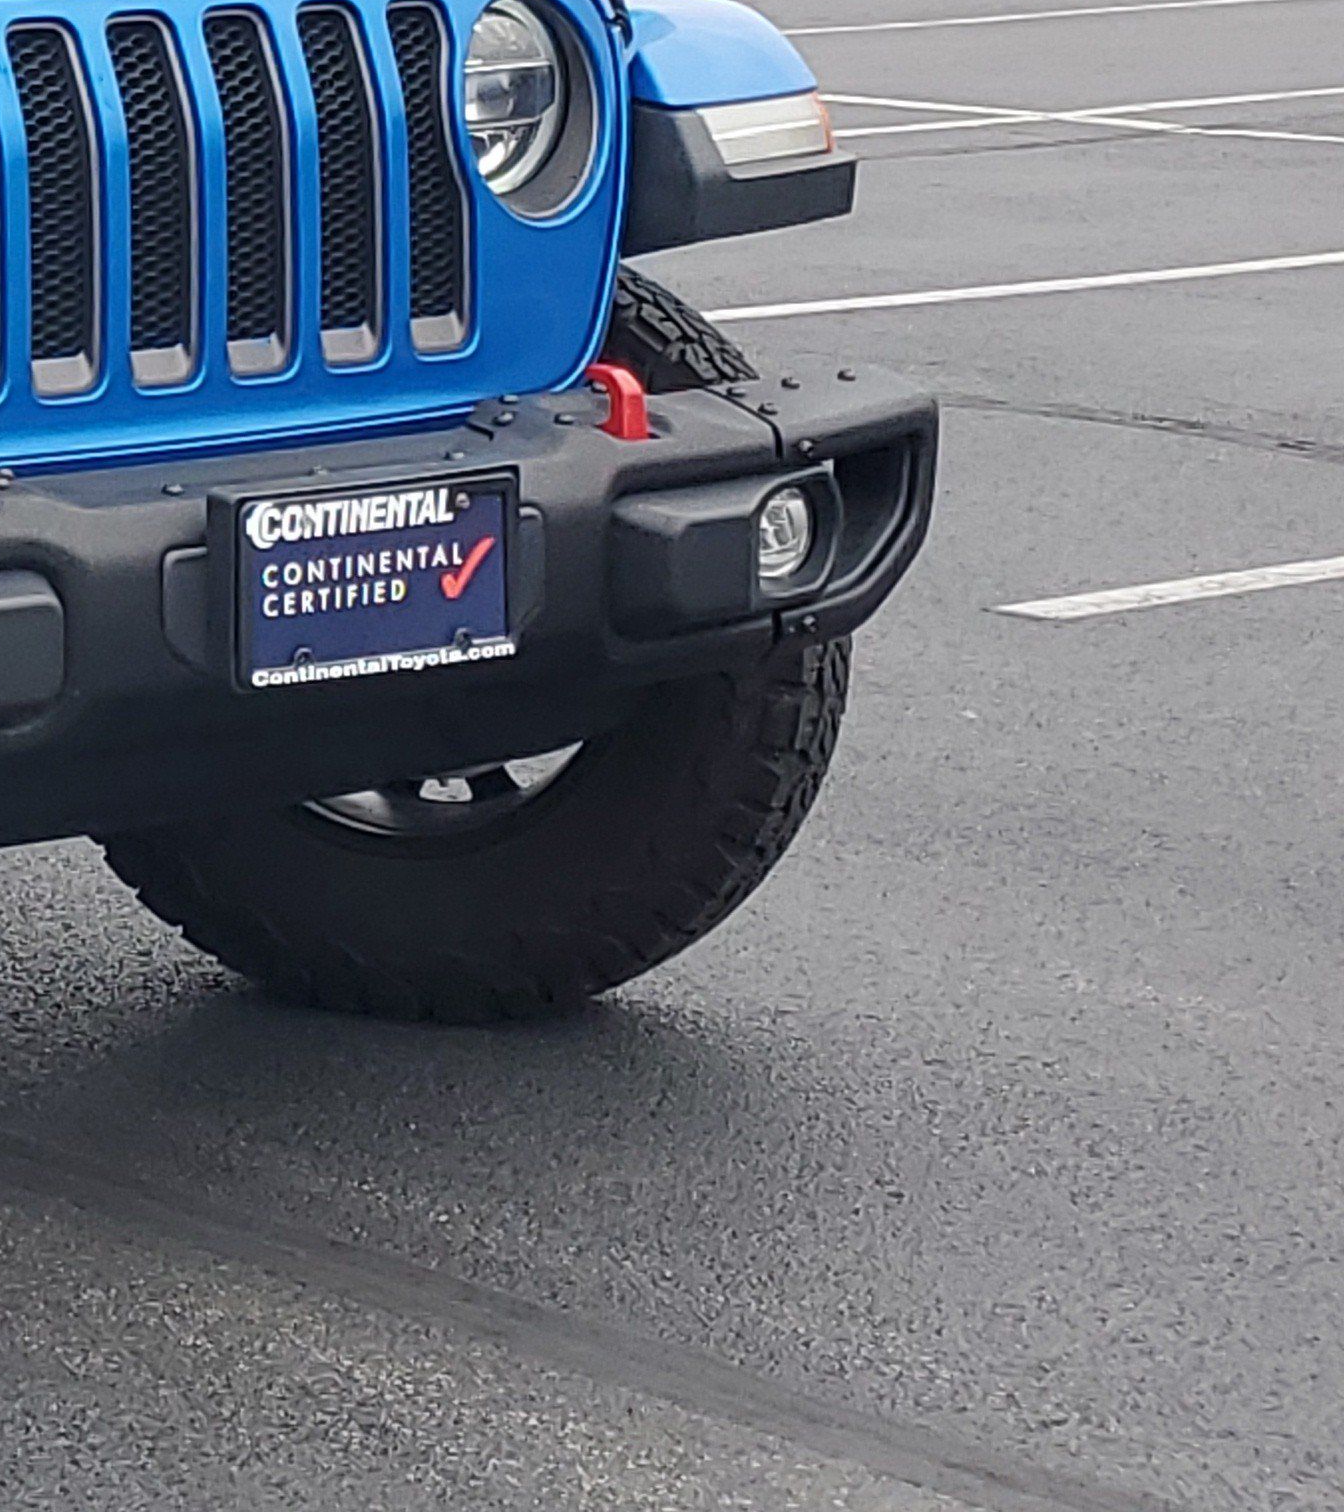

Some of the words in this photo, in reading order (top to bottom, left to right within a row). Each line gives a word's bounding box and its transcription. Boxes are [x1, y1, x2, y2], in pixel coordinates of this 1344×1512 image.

[245, 489, 455, 549] CONTINENTAL
[261, 541, 466, 589] CONTINENTAL
[261, 577, 407, 618] CERTIFIED
[251, 641, 516, 688] ContinentalToyota.com
